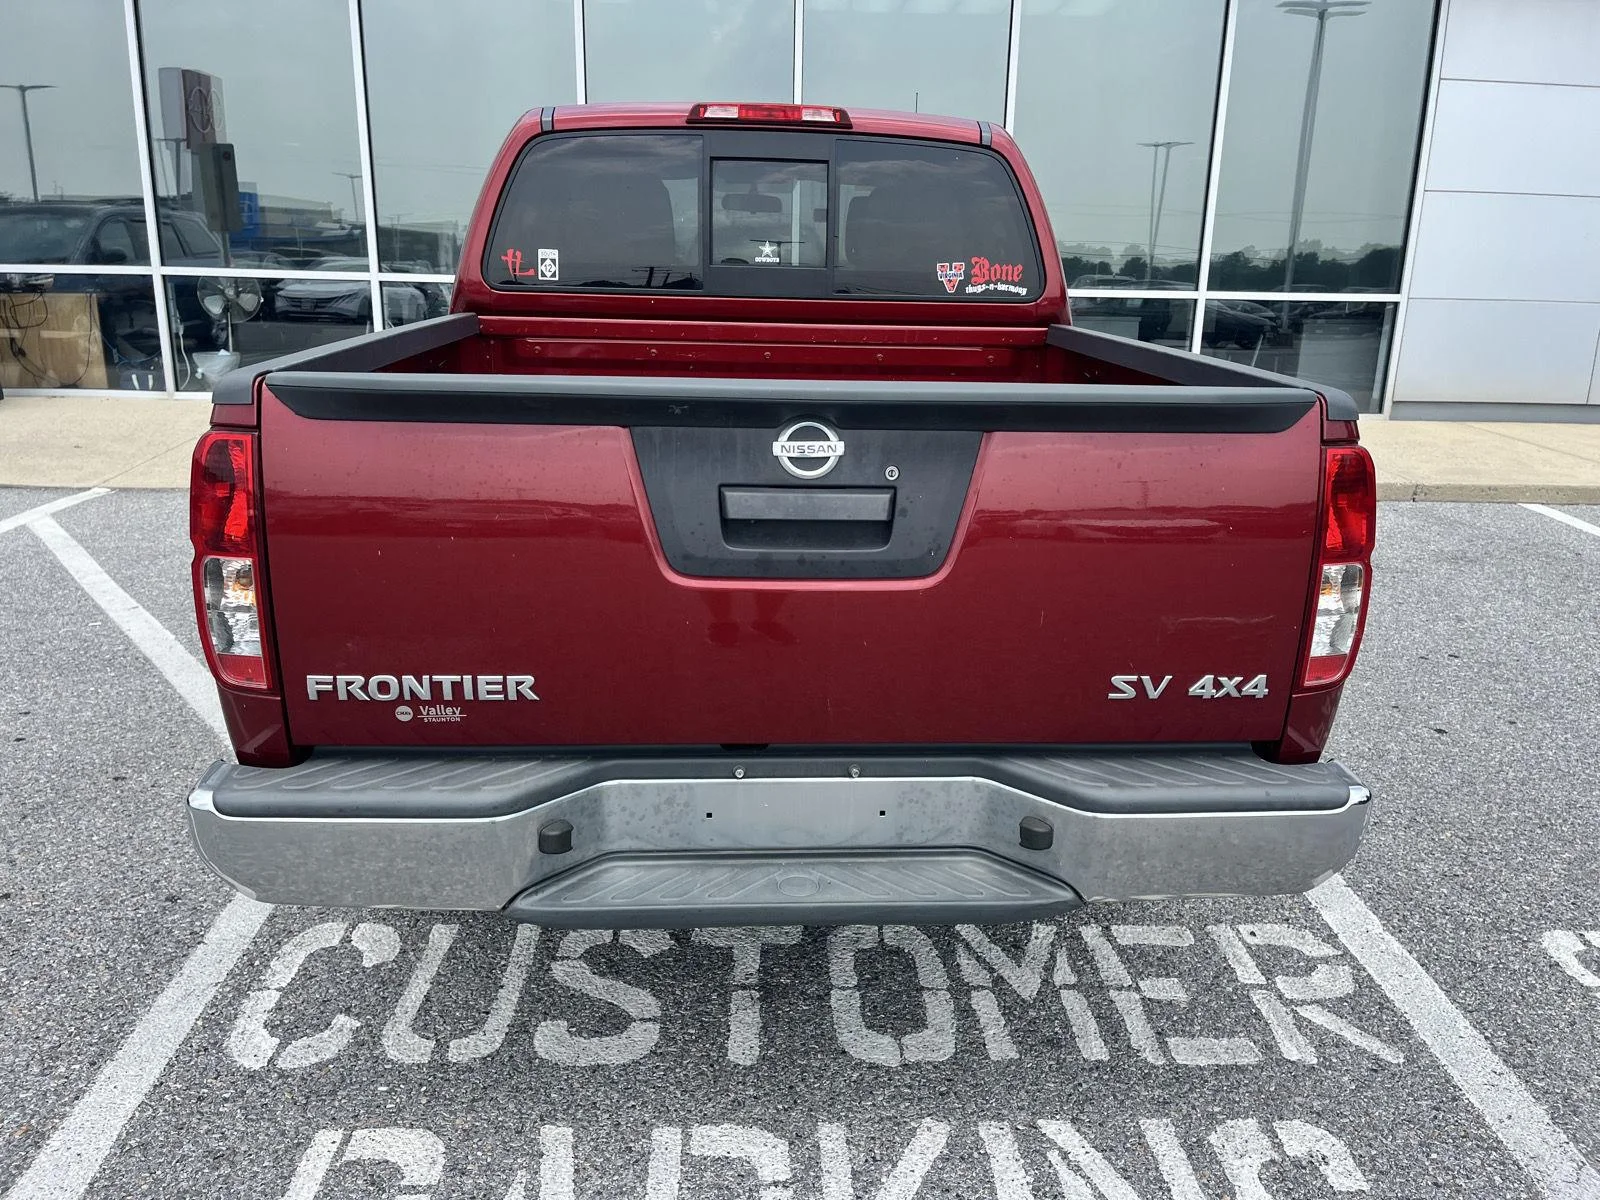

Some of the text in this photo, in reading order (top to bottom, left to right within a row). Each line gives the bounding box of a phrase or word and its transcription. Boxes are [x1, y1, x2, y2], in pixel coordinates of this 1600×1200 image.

[543, 263, 553, 273] 12
[971, 257, 1023, 285] Bone
[781, 444, 837, 454] NISSAN
[306, 674, 541, 701] FRONTIER
[1107, 675, 1173, 700] SV
[419, 704, 461, 717] Valley
[224, 921, 1405, 1069] CUSTOMER
